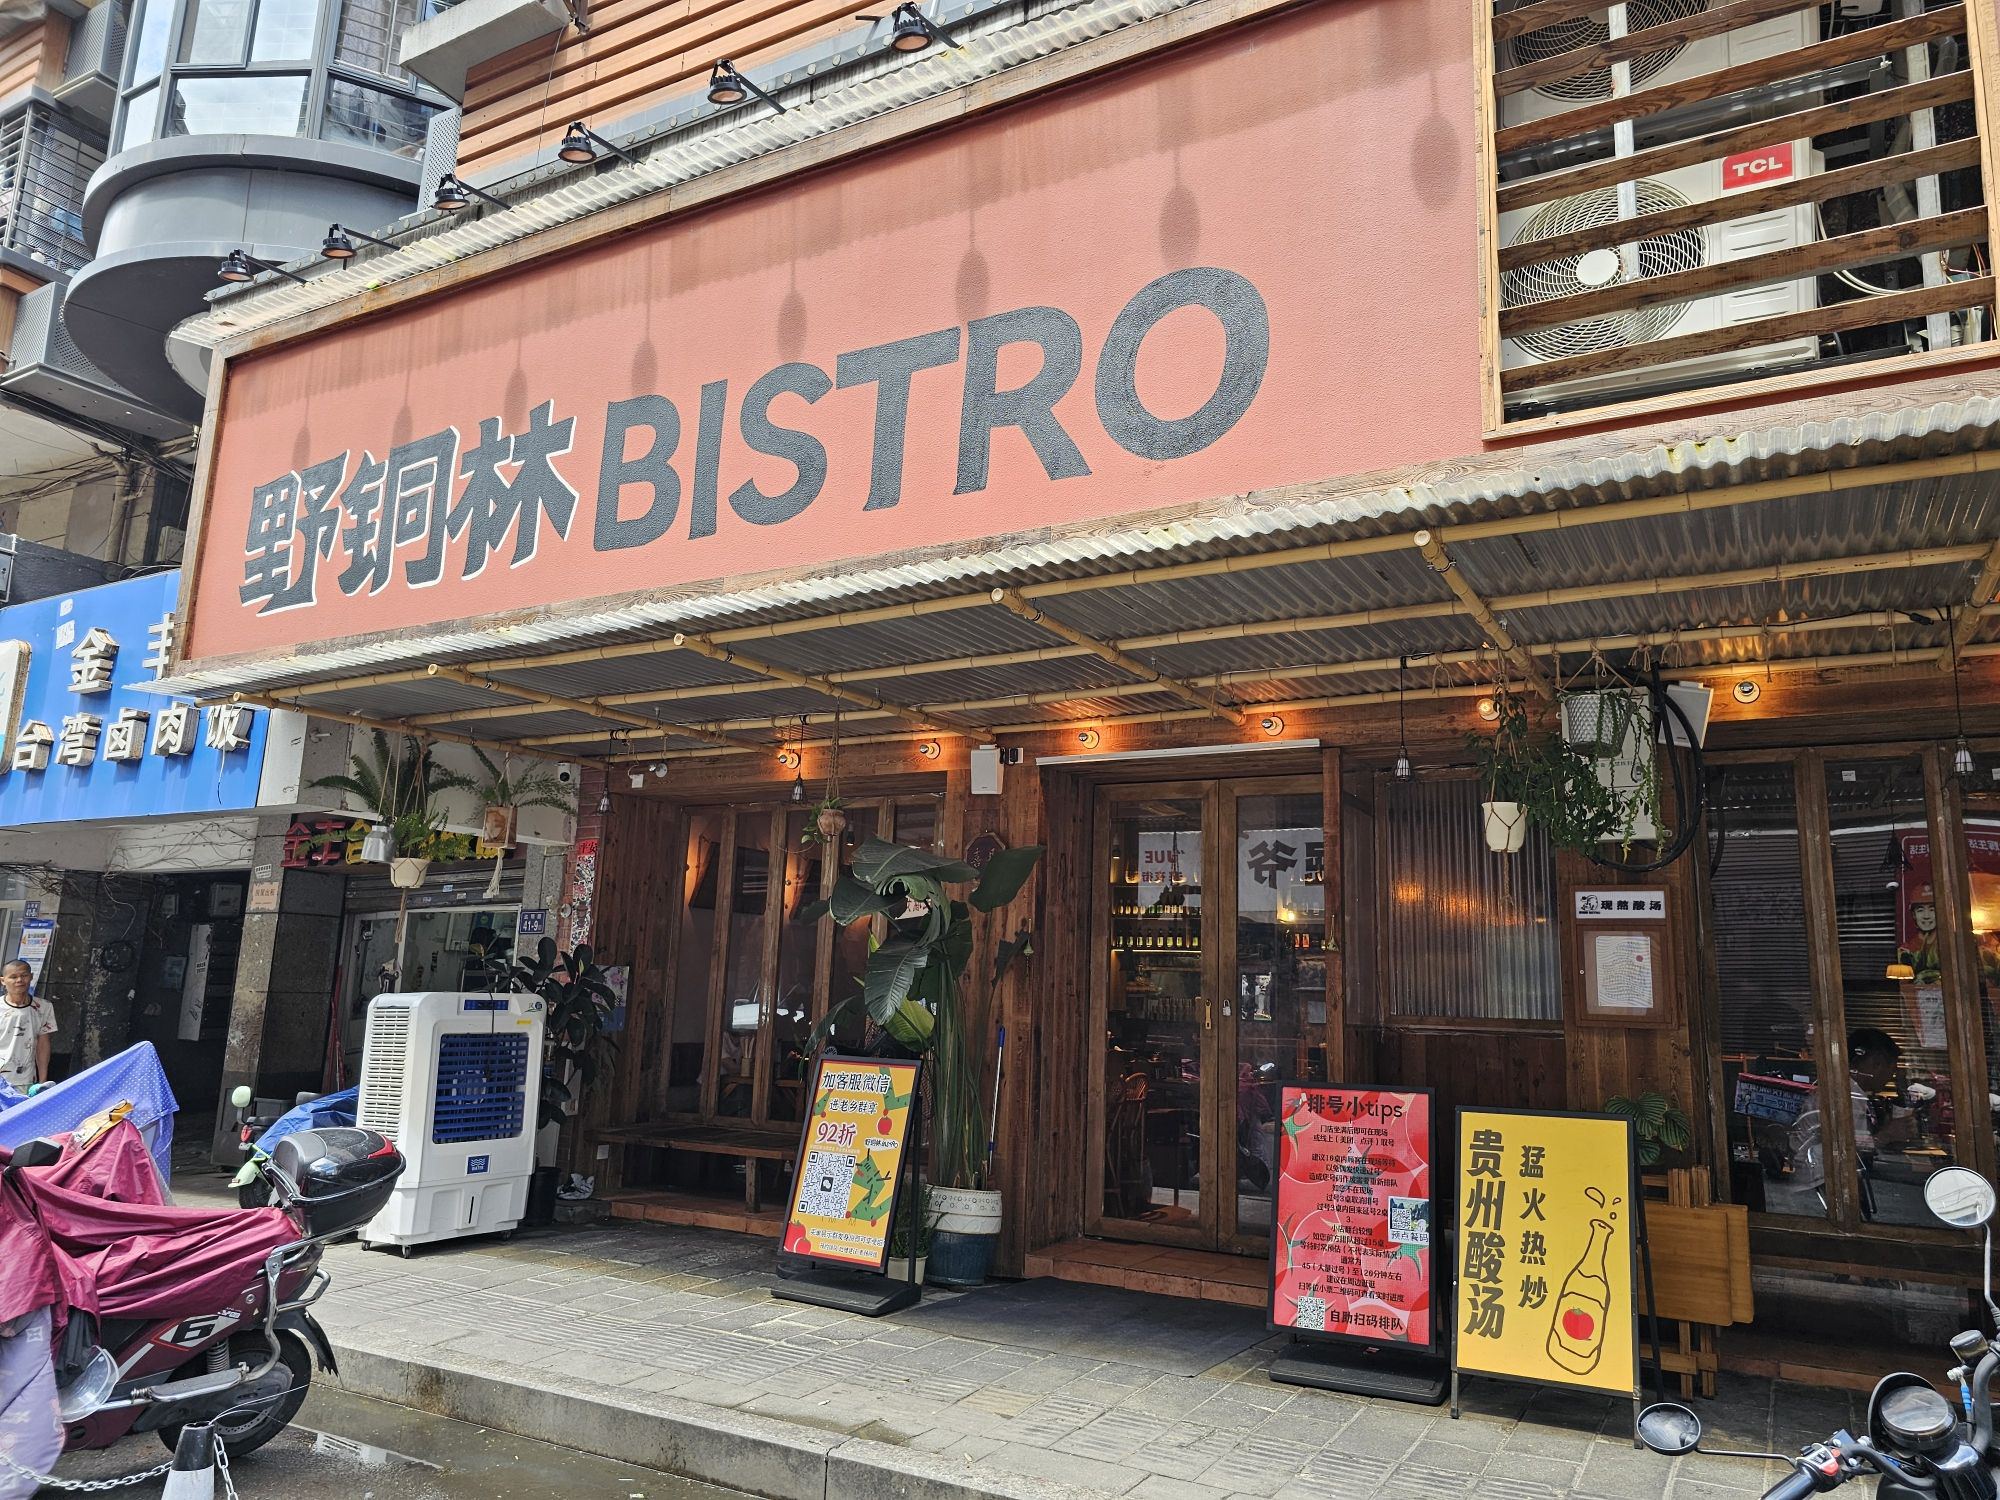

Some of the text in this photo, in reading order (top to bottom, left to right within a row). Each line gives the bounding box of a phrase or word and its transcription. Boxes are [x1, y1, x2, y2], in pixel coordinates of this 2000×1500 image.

[1733, 157, 1782, 176] TCL
[239, 266, 1271, 616] 野銅林 BISTRO
[12, 701, 256, 772] 台湾卤肉饭
[1600, 900, 1662, 911] 现熬酸汤
[821, 1072, 890, 1093] 加客服微信
[830, 1099, 877, 1114] 进老乡群享
[1308, 1094, 1403, 1124] 排号小tips
[818, 1122, 856, 1146] 92折
[1391, 1230, 1429, 1243] 预点餐码
[1463, 1129, 1506, 1340] 贵州酸汤
[1518, 1144, 1549, 1310] 猛火热炒
[1340, 1255, 1362, 1265] 通常为
[1326, 1275, 1376, 1288] 建议在周边逛逛
[1330, 1310, 1403, 1331] 自助扫码排队
